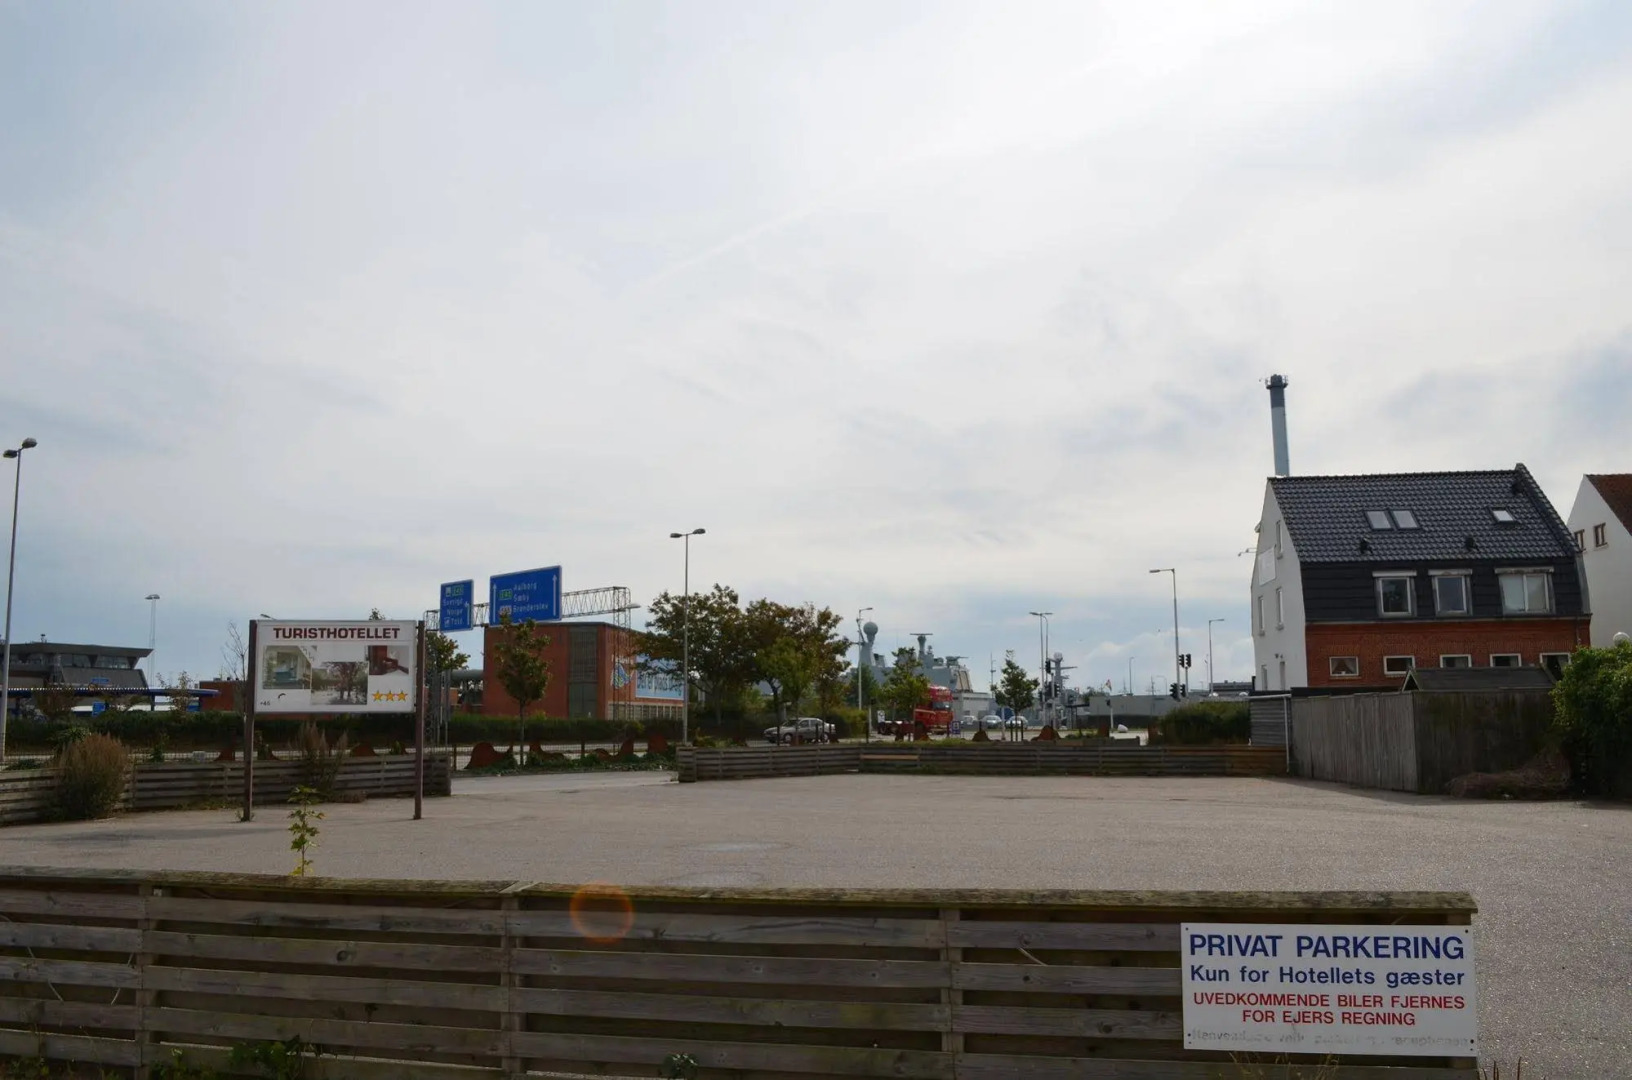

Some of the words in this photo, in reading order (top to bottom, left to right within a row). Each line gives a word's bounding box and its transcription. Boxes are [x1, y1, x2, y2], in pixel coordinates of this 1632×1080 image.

[273, 628, 401, 639] TURISTHOTELLET
[1190, 933, 1283, 957] PRIVAT
[1297, 935, 1464, 960] PARKERING
[1190, 965, 1230, 982] Kun
[1240, 965, 1270, 983] for
[1280, 966, 1376, 985] Hotellets
[1386, 970, 1465, 988] gæster
[1194, 992, 1330, 1007] UVEDKOMMENDE
[1338, 994, 1384, 1008] BILER
[1390, 995, 1465, 1009] FJERNES
[1242, 1010, 1276, 1023] FOR
[1282, 1011, 1335, 1025] EJERS
[1341, 1011, 1416, 1026] REGNING
